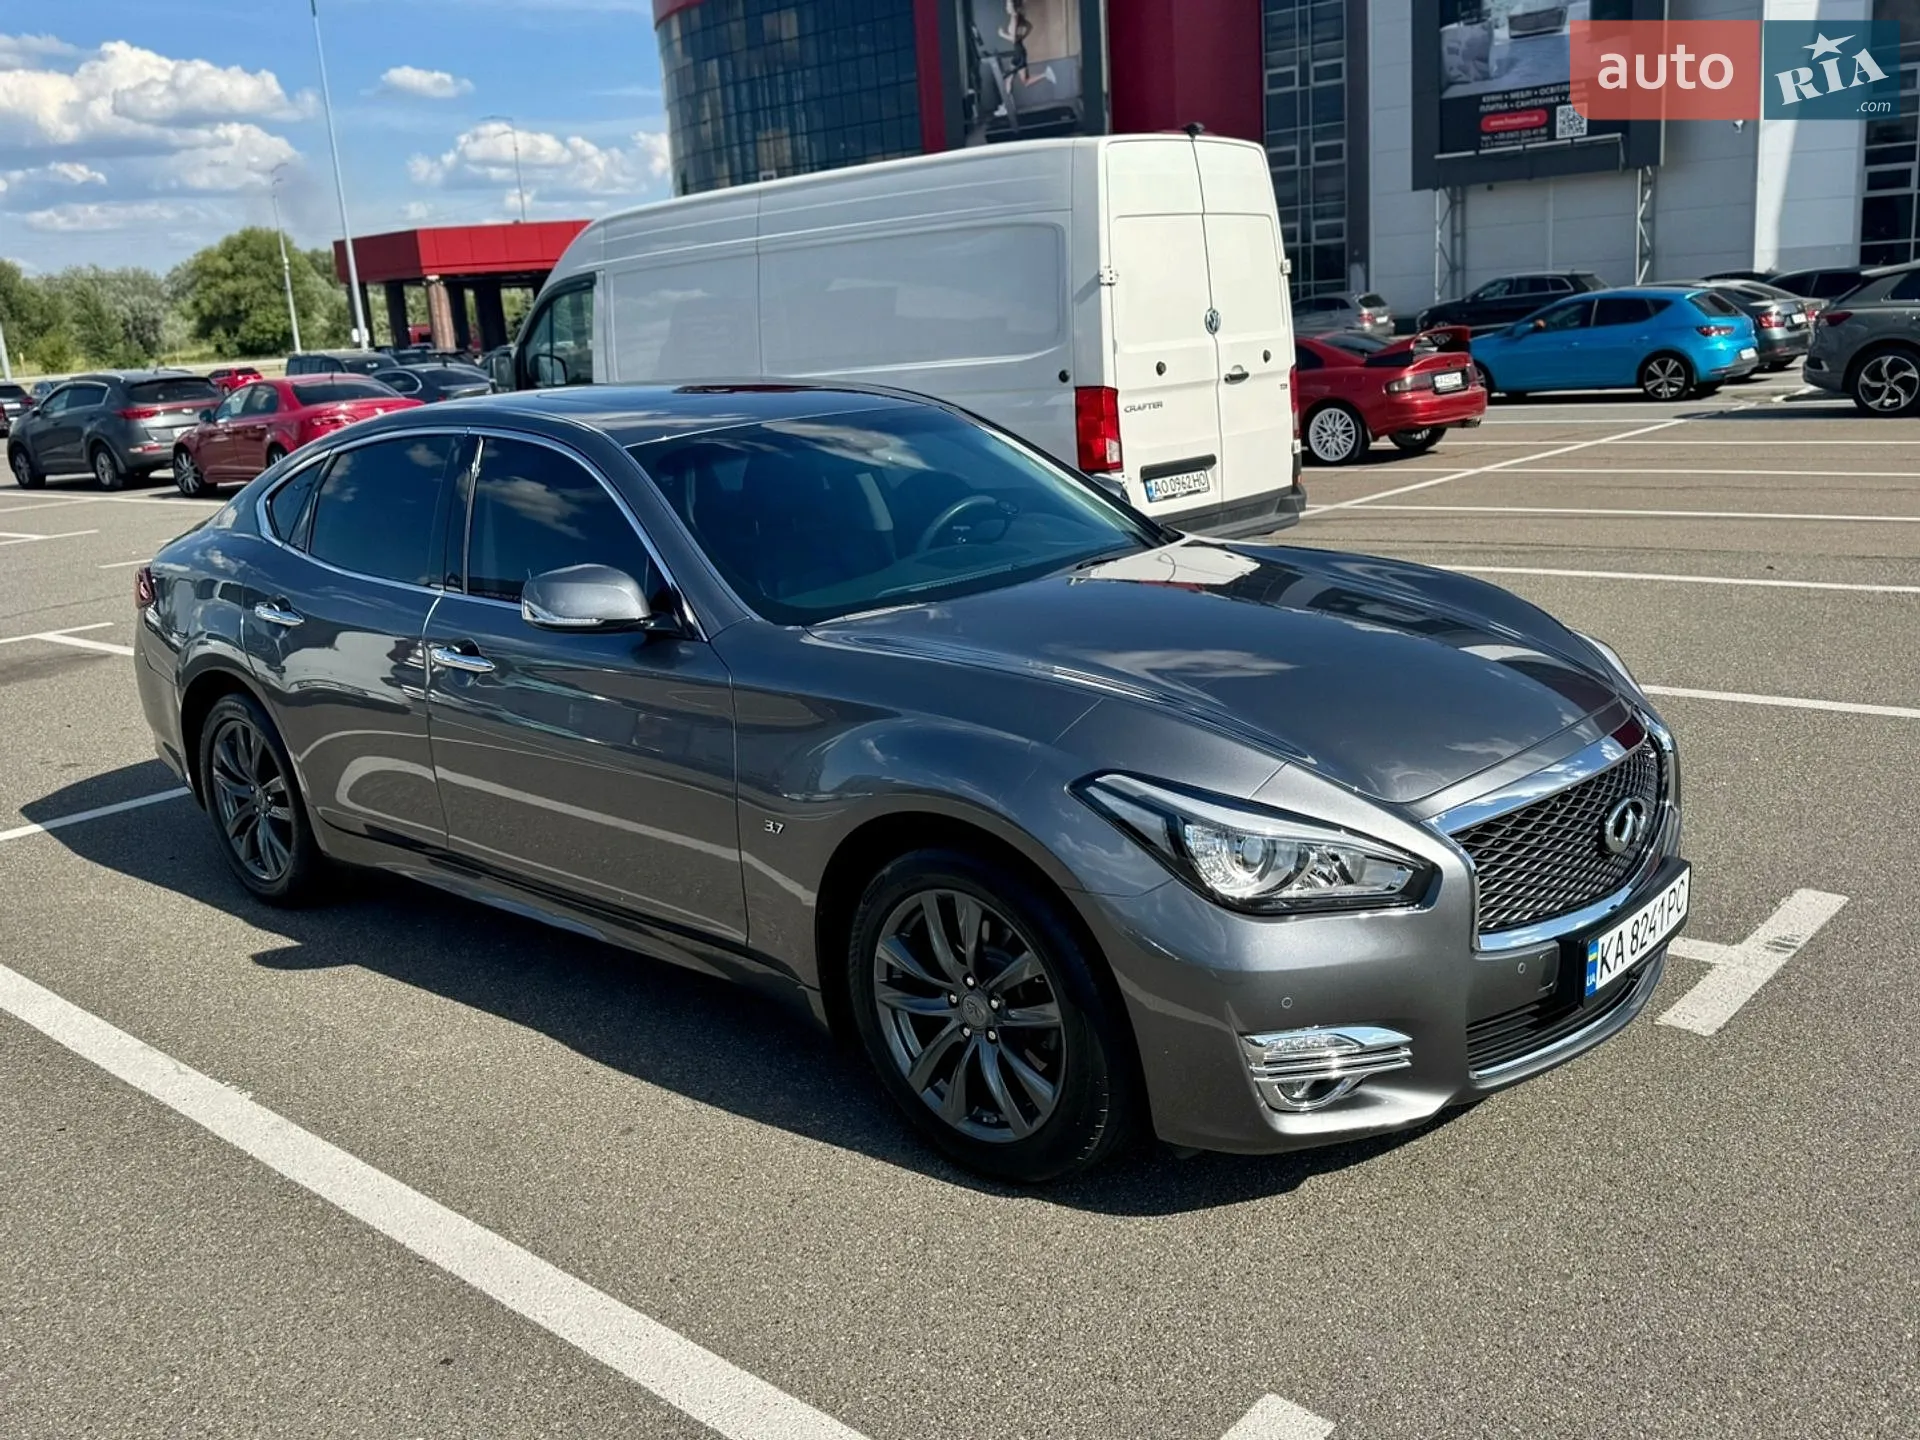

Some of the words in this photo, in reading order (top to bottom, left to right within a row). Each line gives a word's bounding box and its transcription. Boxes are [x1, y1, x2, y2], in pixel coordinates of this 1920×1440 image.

[1124, 401, 1164, 414] CRAFTER
[764, 819, 784, 835] 3.7
[1600, 930, 1625, 981] KA
